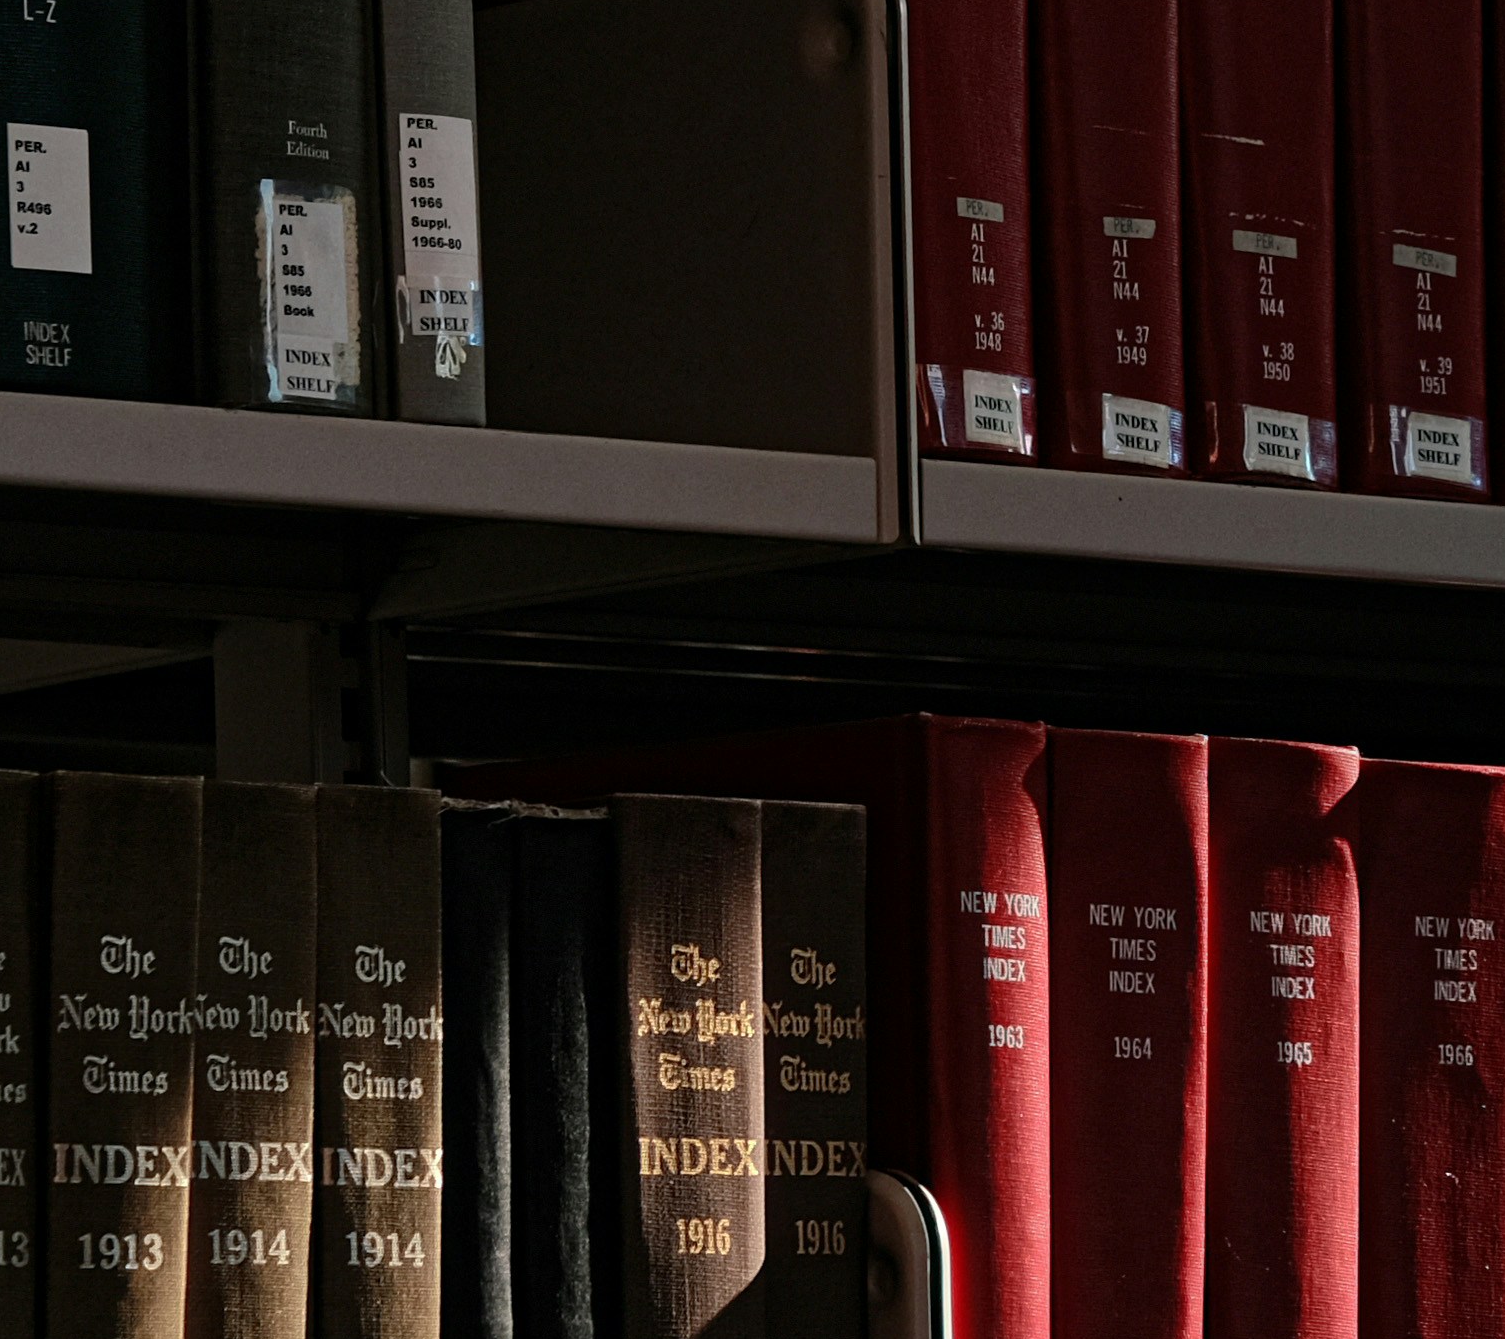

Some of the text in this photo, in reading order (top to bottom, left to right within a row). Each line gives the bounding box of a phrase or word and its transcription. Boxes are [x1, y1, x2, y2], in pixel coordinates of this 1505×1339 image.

[287, 141, 329, 160] Edition
[975, 331, 1001, 351] 1948
[975, 395, 1011, 412] INDEX
[1090, 904, 1176, 930] NEW YORK
[1109, 937, 1156, 961] TIMES
[1109, 971, 1155, 994] INDEX
[1114, 1037, 1152, 1059] 1964
[639, 1135, 757, 1175] INDEX
[676, 1218, 730, 1254] 1916
